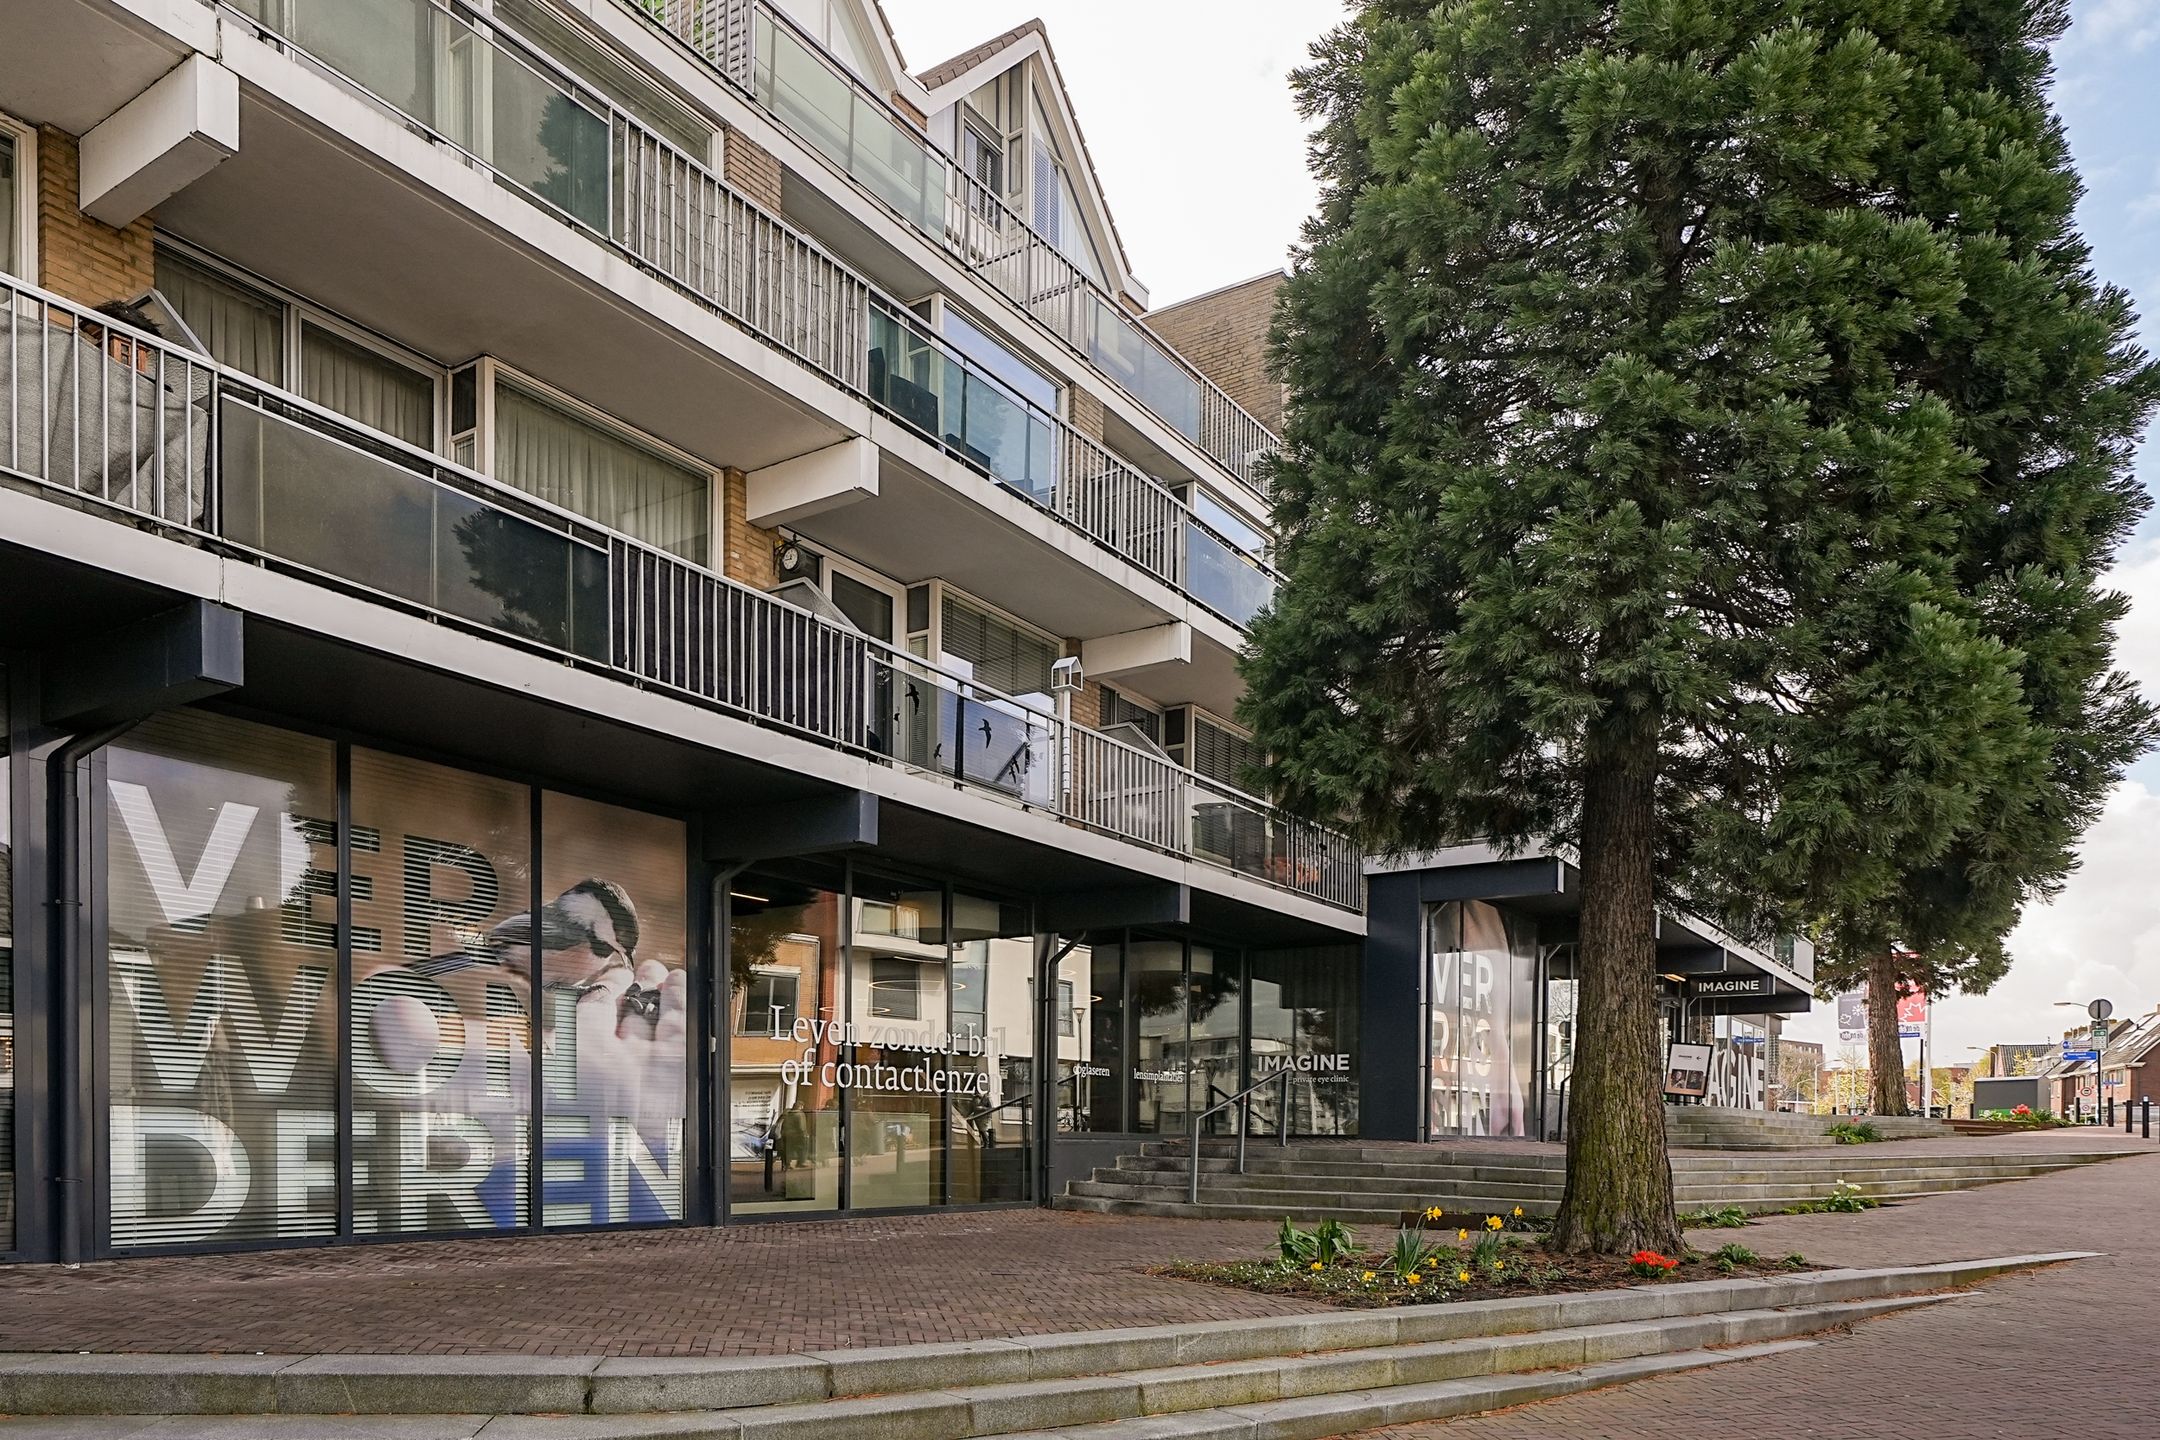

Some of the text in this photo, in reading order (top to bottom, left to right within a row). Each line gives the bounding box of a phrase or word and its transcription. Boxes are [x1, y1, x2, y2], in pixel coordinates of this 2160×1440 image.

[106, 779, 500, 956] VER
[1433, 952, 1493, 1015] VER
[1698, 980, 1760, 993] IMAGINE
[111, 949, 579, 1101] WON
[770, 1004, 1009, 1060] Leven zonder bril
[781, 1048, 1005, 1096] of contactlenzen
[1073, 1062, 1110, 1078] ooglaseren
[1258, 1053, 1350, 1072] IMAGINE
[1292, 1074, 1350, 1084] private eye clinic
[109, 1104, 687, 1248] DEREN
